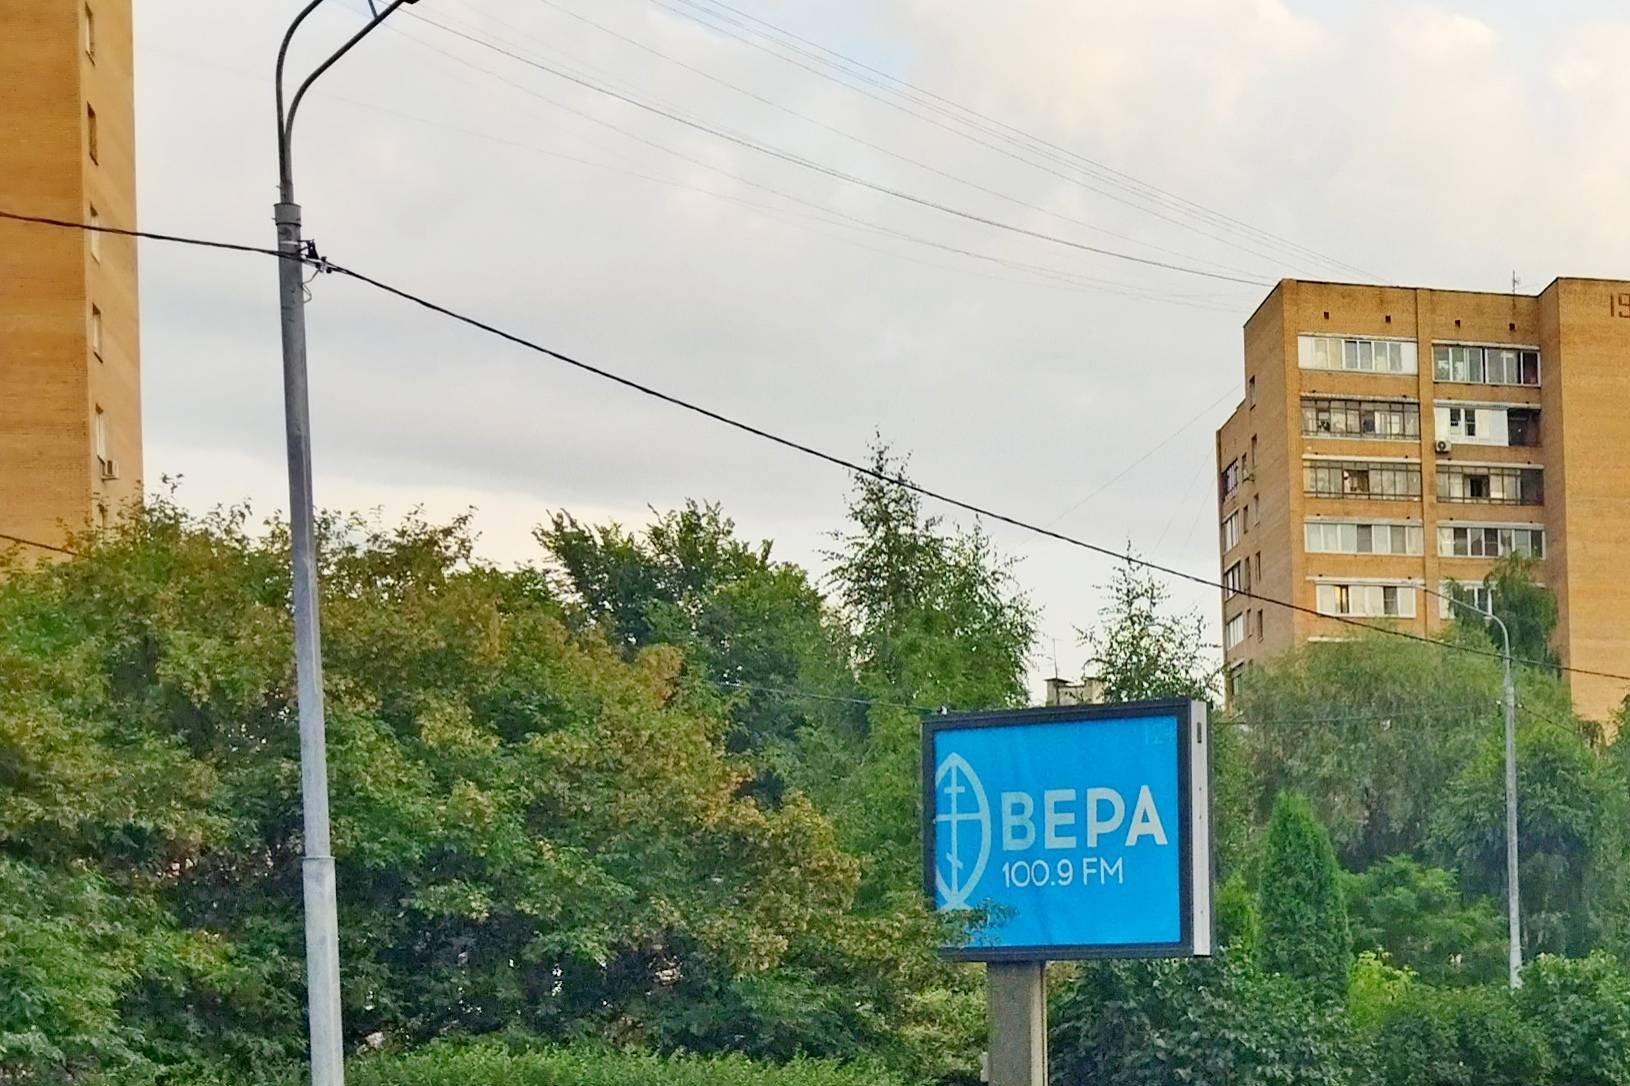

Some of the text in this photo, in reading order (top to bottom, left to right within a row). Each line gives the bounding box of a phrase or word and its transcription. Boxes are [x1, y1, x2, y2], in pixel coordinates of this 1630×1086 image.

[1001, 784, 1168, 851] ВЕРА
[1002, 857, 1124, 888] 100.9 FM
